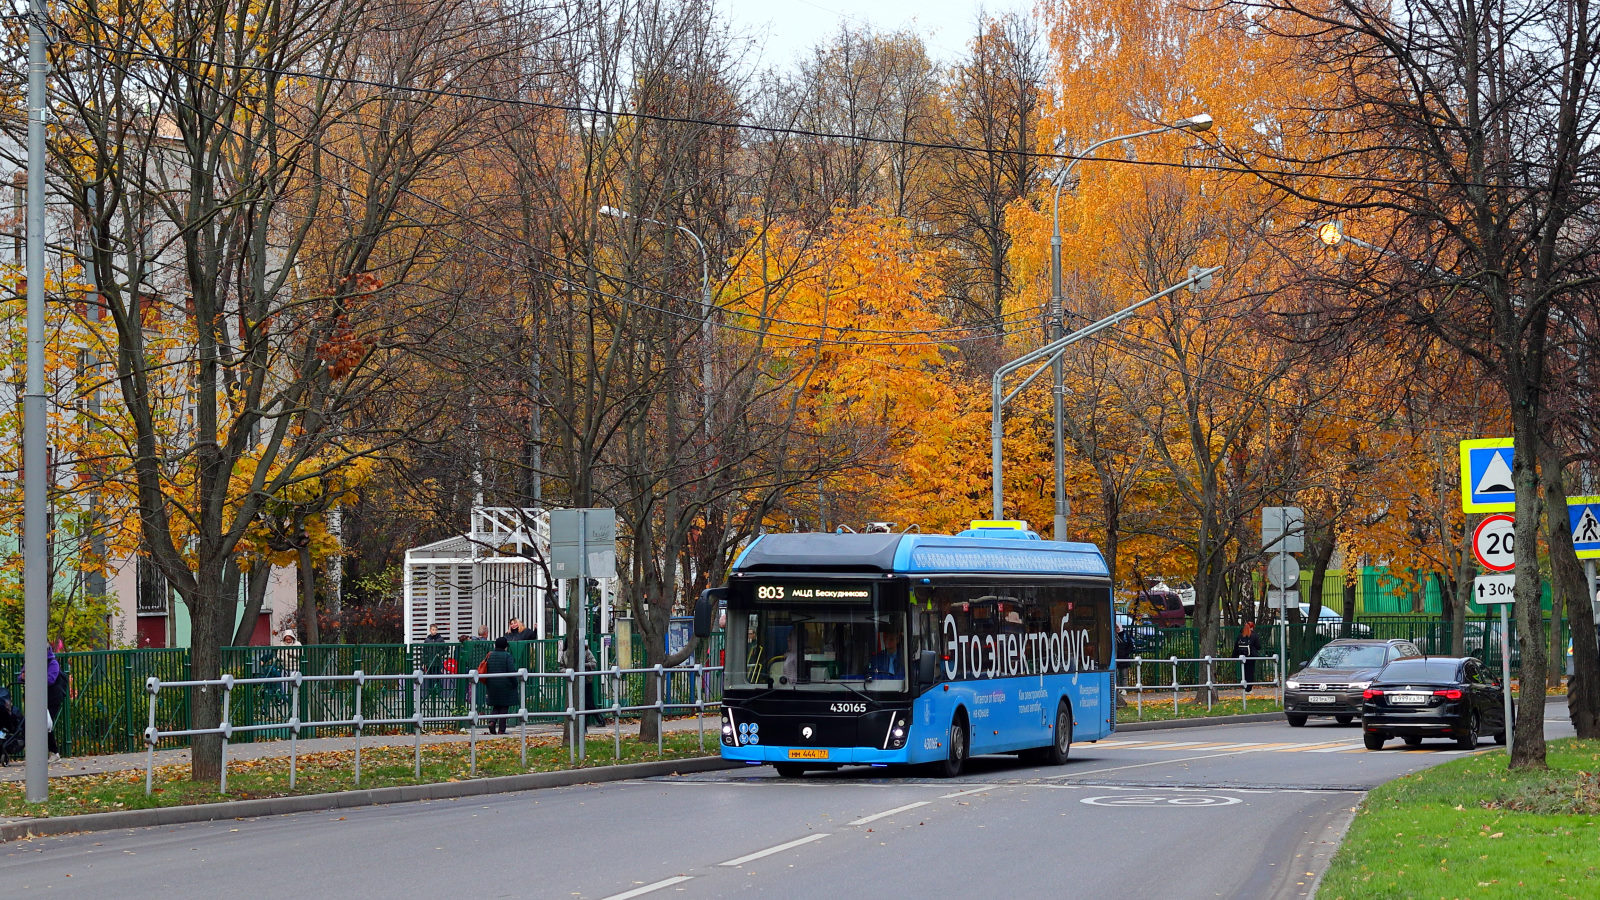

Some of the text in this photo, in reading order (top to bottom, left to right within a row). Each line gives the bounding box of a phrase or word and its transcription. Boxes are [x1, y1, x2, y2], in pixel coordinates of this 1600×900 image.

[1487, 533, 1514, 554] 20
[758, 586, 784, 599] 803
[792, 589, 813, 598] МЦД
[943, 613, 1095, 688] Это электробус.
[830, 703, 867, 713] 430165
[803, 750, 816, 758] 444
